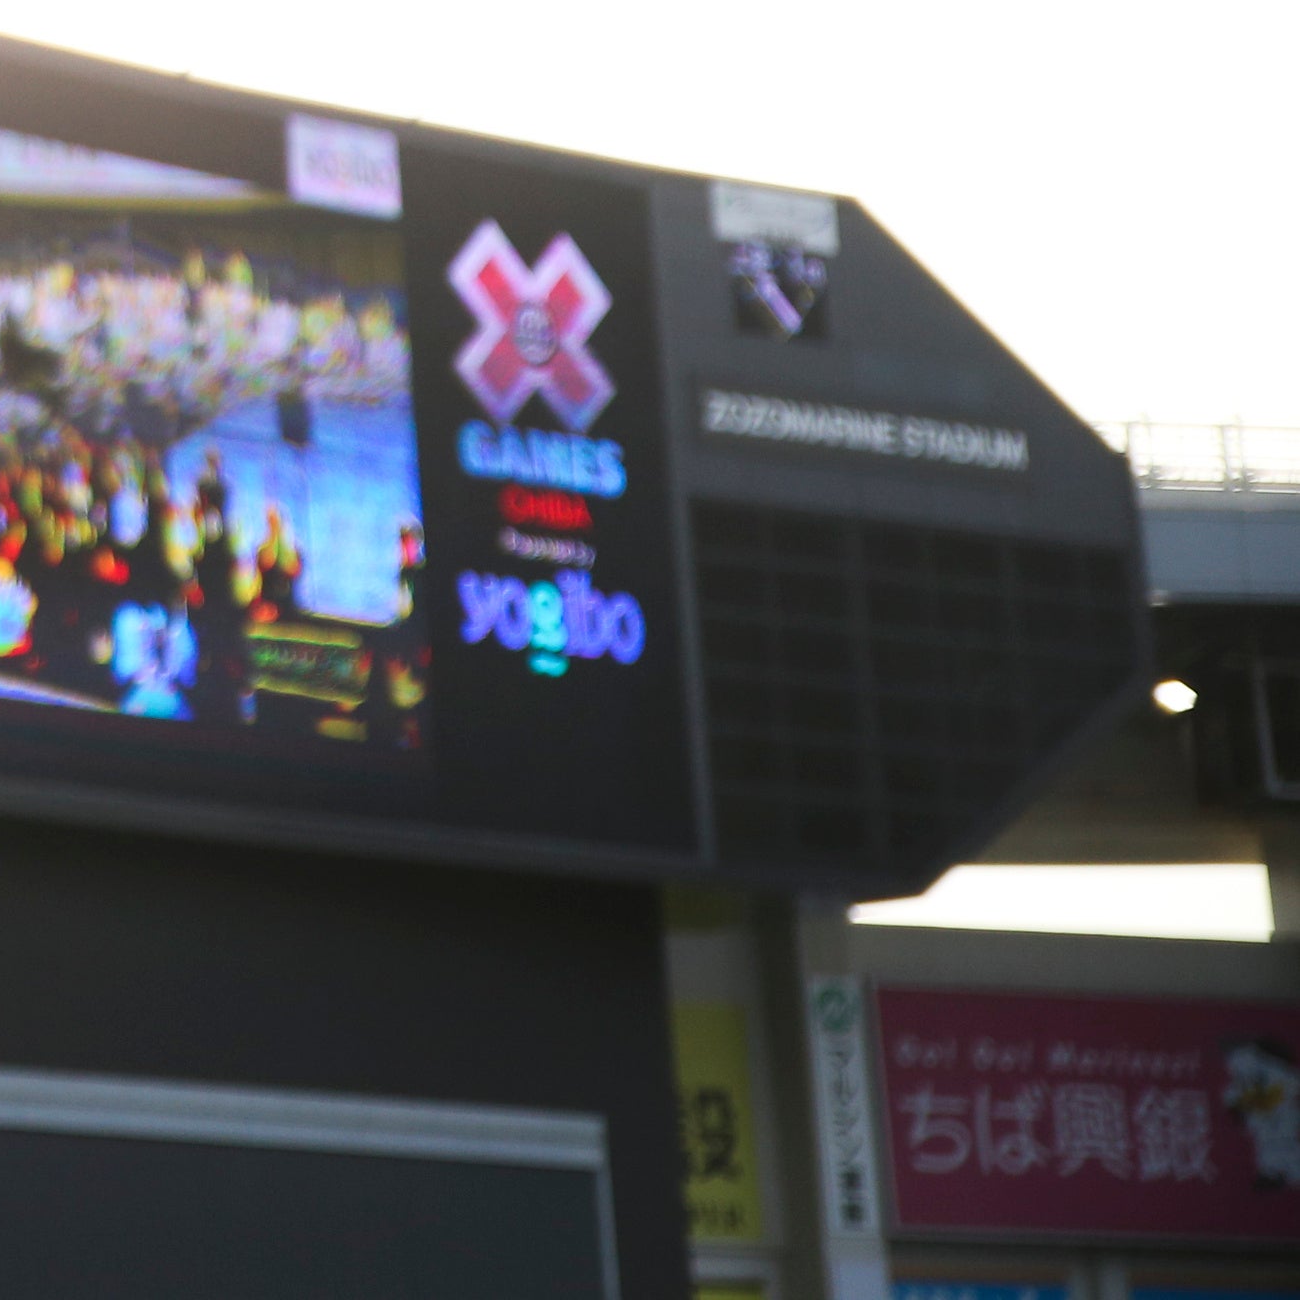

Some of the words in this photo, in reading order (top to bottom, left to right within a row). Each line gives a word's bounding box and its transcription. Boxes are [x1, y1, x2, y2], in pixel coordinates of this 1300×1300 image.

[456, 419, 627, 498] GAMES
[902, 415, 1030, 471] STADIUM
[898, 1080, 1219, 1186] ちば興銀
